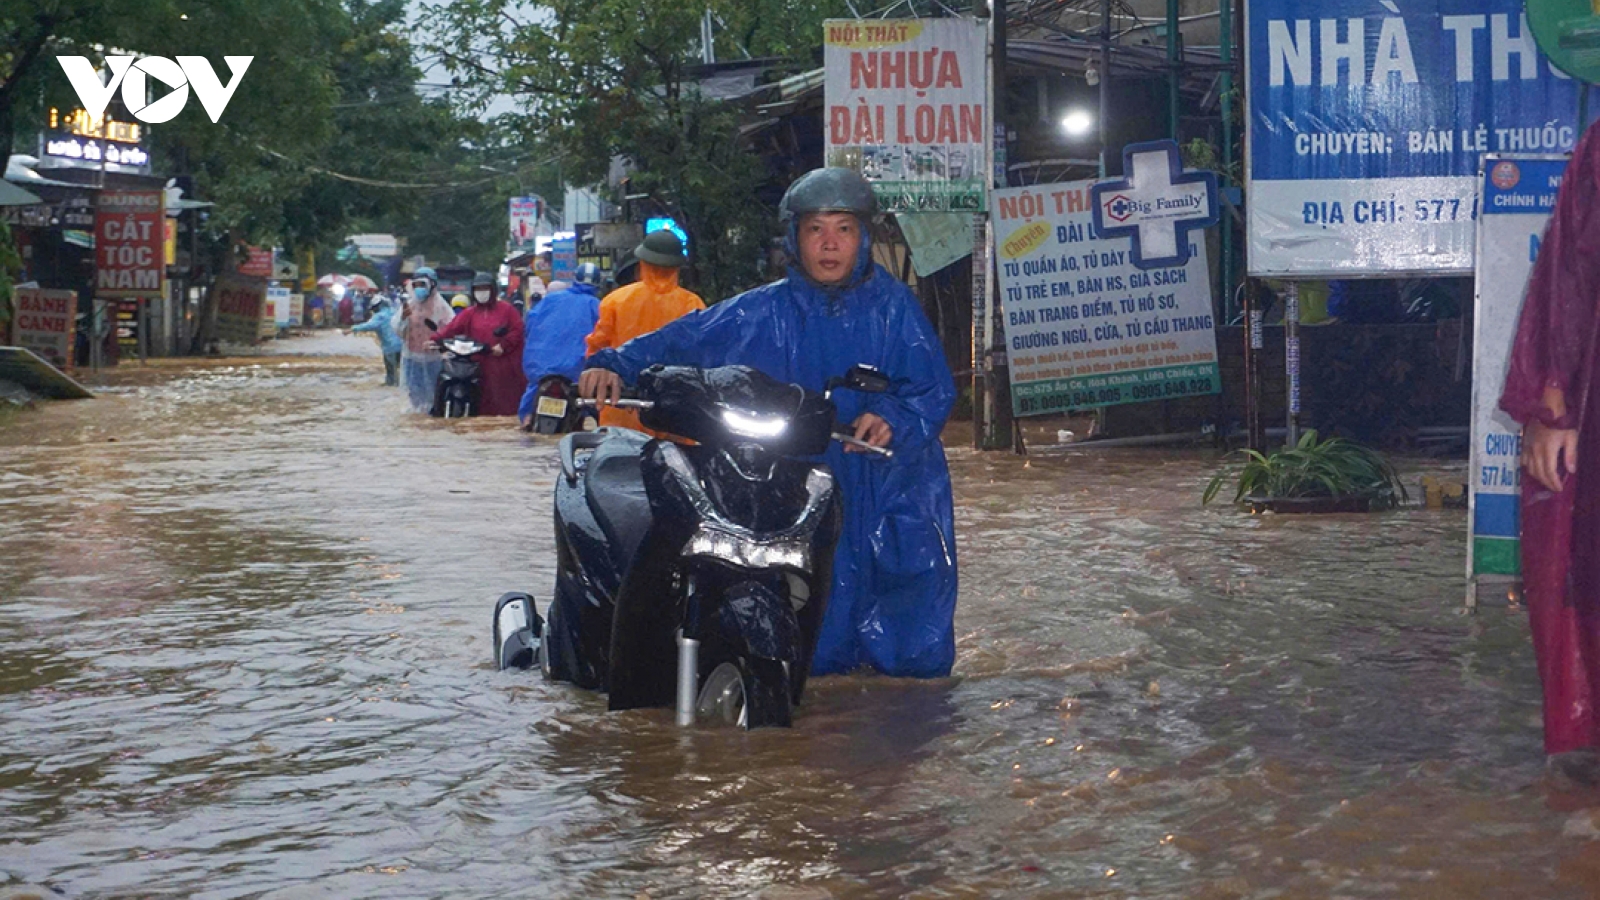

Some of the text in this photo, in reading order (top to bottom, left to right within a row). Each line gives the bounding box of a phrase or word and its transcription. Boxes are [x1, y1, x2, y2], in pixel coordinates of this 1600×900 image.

[829, 23, 908, 45] NỘI THẤT
[1268, 0, 1419, 86] NHÀ
[850, 47, 963, 97] NHỰA
[829, 97, 982, 145] ĐÀI LOAN
[1295, 119, 1573, 155] CHUYÊN: BÁN LẺ THUỐC
[1000, 191, 1044, 222] NỘI
[1128, 194, 1201, 214] Big Family
[1303, 201, 1344, 230] ĐỊA
[1353, 193, 1404, 224] CHỈ:
[1415, 199, 1460, 221] 577
[1494, 192, 1535, 206] CHÍNH
[104, 214, 154, 240] CẮT
[1057, 220, 1083, 243] ĐÀI
[103, 242, 153, 266] TÓC
[1003, 225, 1046, 258] Chuyên
[1004, 258, 1019, 277] TỦ
[1059, 253, 1080, 272] ÁO,
[1083, 249, 1098, 269] TỦ
[99, 270, 158, 289] NAM
[1006, 282, 1022, 301] TỦ
[1025, 279, 1047, 300] TRẺ
[1051, 280, 1074, 299] EM,
[1077, 275, 1102, 294] BÀN
[1106, 275, 1126, 292] HS,
[1153, 266, 1187, 286] SÁCH
[19, 291, 68, 313] BÁNH
[1009, 306, 1035, 325] BÀN
[1039, 305, 1078, 323] TRANG
[1120, 294, 1135, 313] TỦ
[18, 315, 66, 332] CANH
[1012, 329, 1059, 350] GIƯỜNG
[1061, 323, 1091, 345] NGỦ,
[1094, 320, 1123, 342] CỬA,
[1126, 319, 1141, 337] TỦ
[1172, 314, 1212, 332] THANG
[1482, 466, 1499, 485] 577
